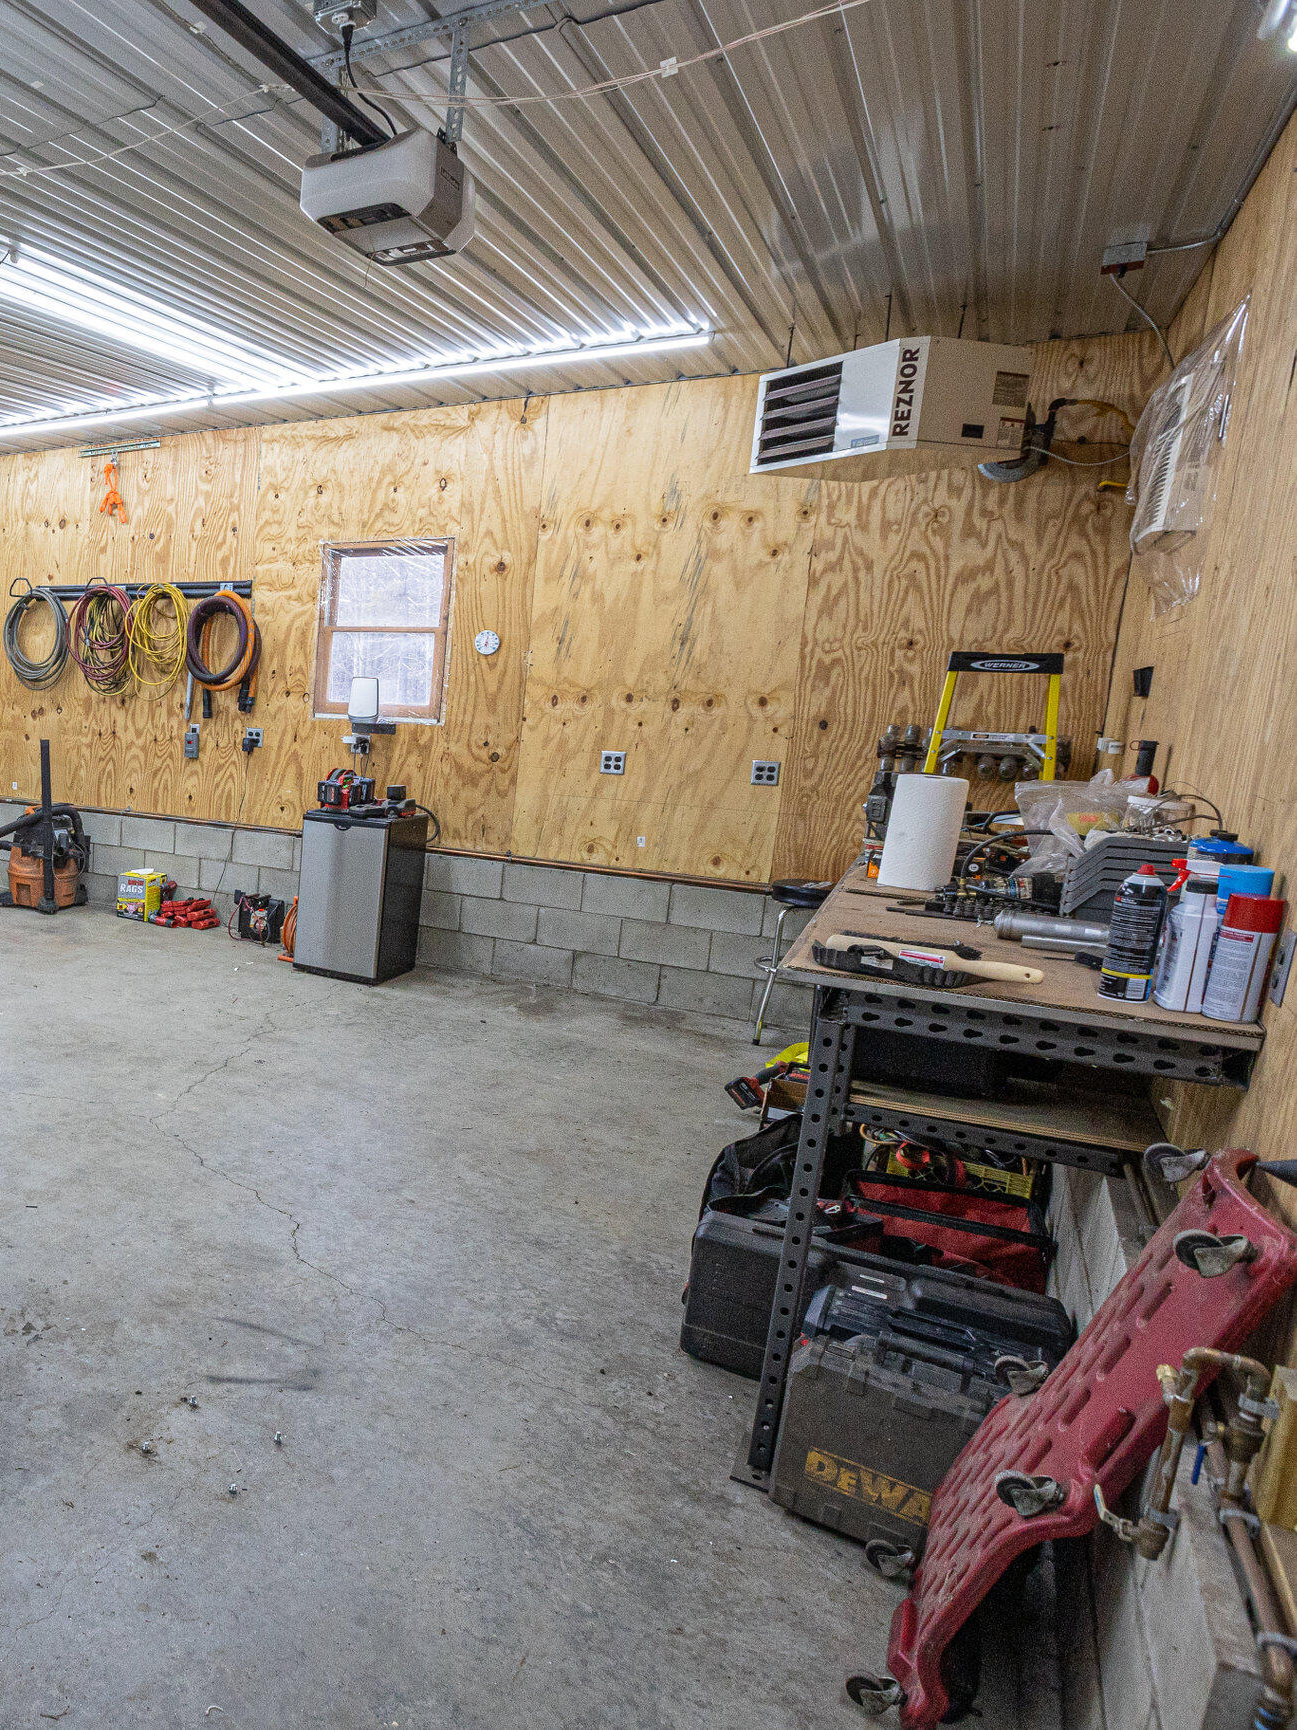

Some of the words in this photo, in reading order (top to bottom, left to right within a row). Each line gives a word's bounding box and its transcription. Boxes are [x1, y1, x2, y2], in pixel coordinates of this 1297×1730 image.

[892, 347, 920, 437] REZNOR
[983, 661, 1027, 670] WERNER
[119, 883, 144, 894] RAGS
[804, 1450, 931, 1524] DEWA
